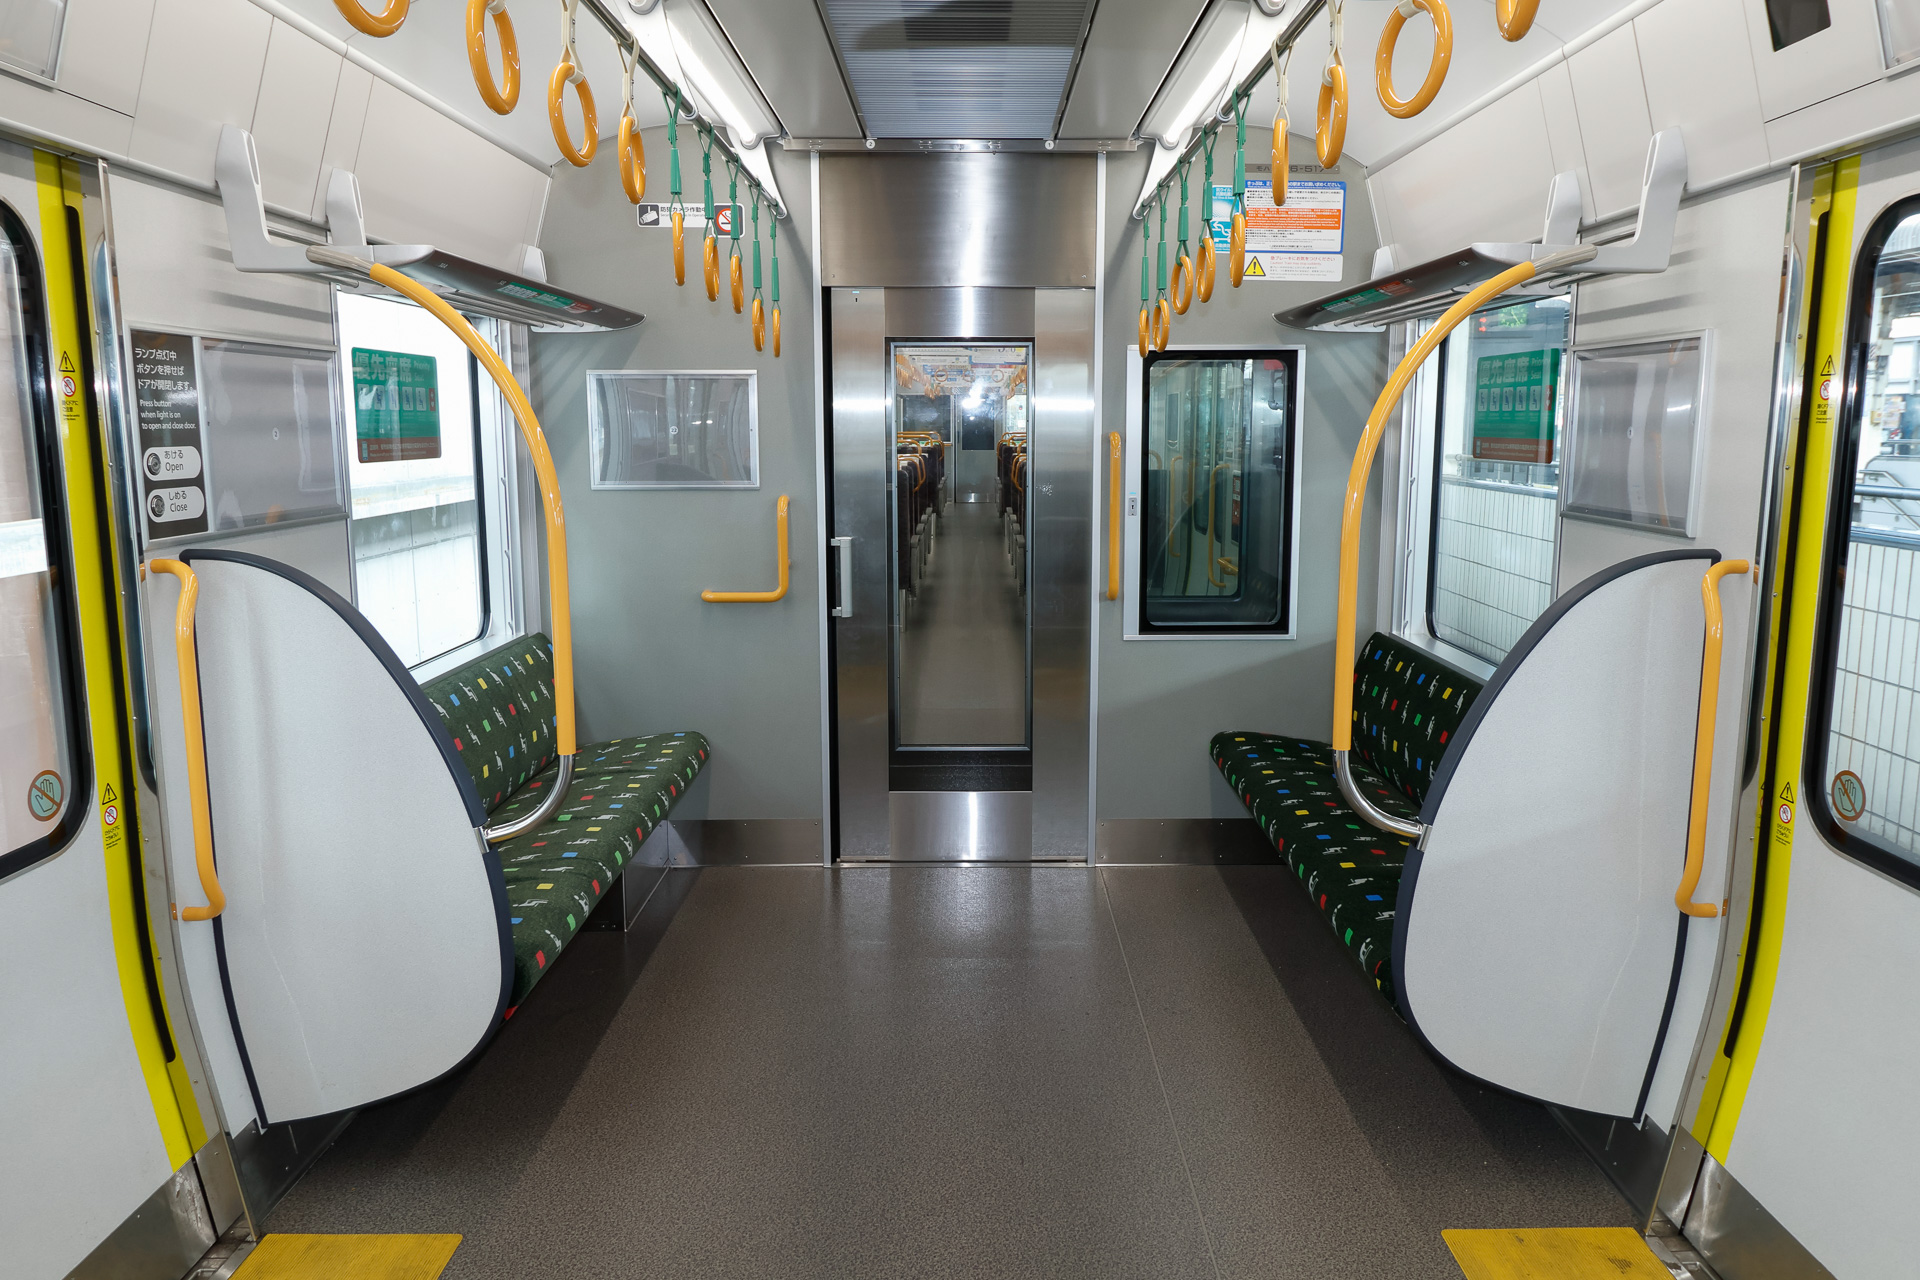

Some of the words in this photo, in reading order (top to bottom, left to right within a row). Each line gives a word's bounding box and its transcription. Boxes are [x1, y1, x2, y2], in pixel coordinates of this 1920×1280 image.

[135, 348, 177, 361] ランプ点灯中
[136, 363, 185, 376] ボタンを押せば
[137, 378, 193, 391] ドアが開閉します。
[140, 399, 154, 407] Press
[154, 399, 172, 408] button
[157, 411, 169, 420] light
[148, 423, 161, 431] open
[172, 421, 184, 429] close
[184, 421, 196, 429] door.
[164, 449, 184, 460] あける
[165, 462, 184, 473] Open
[168, 490, 187, 501] しめる
[169, 502, 188, 512] Close
